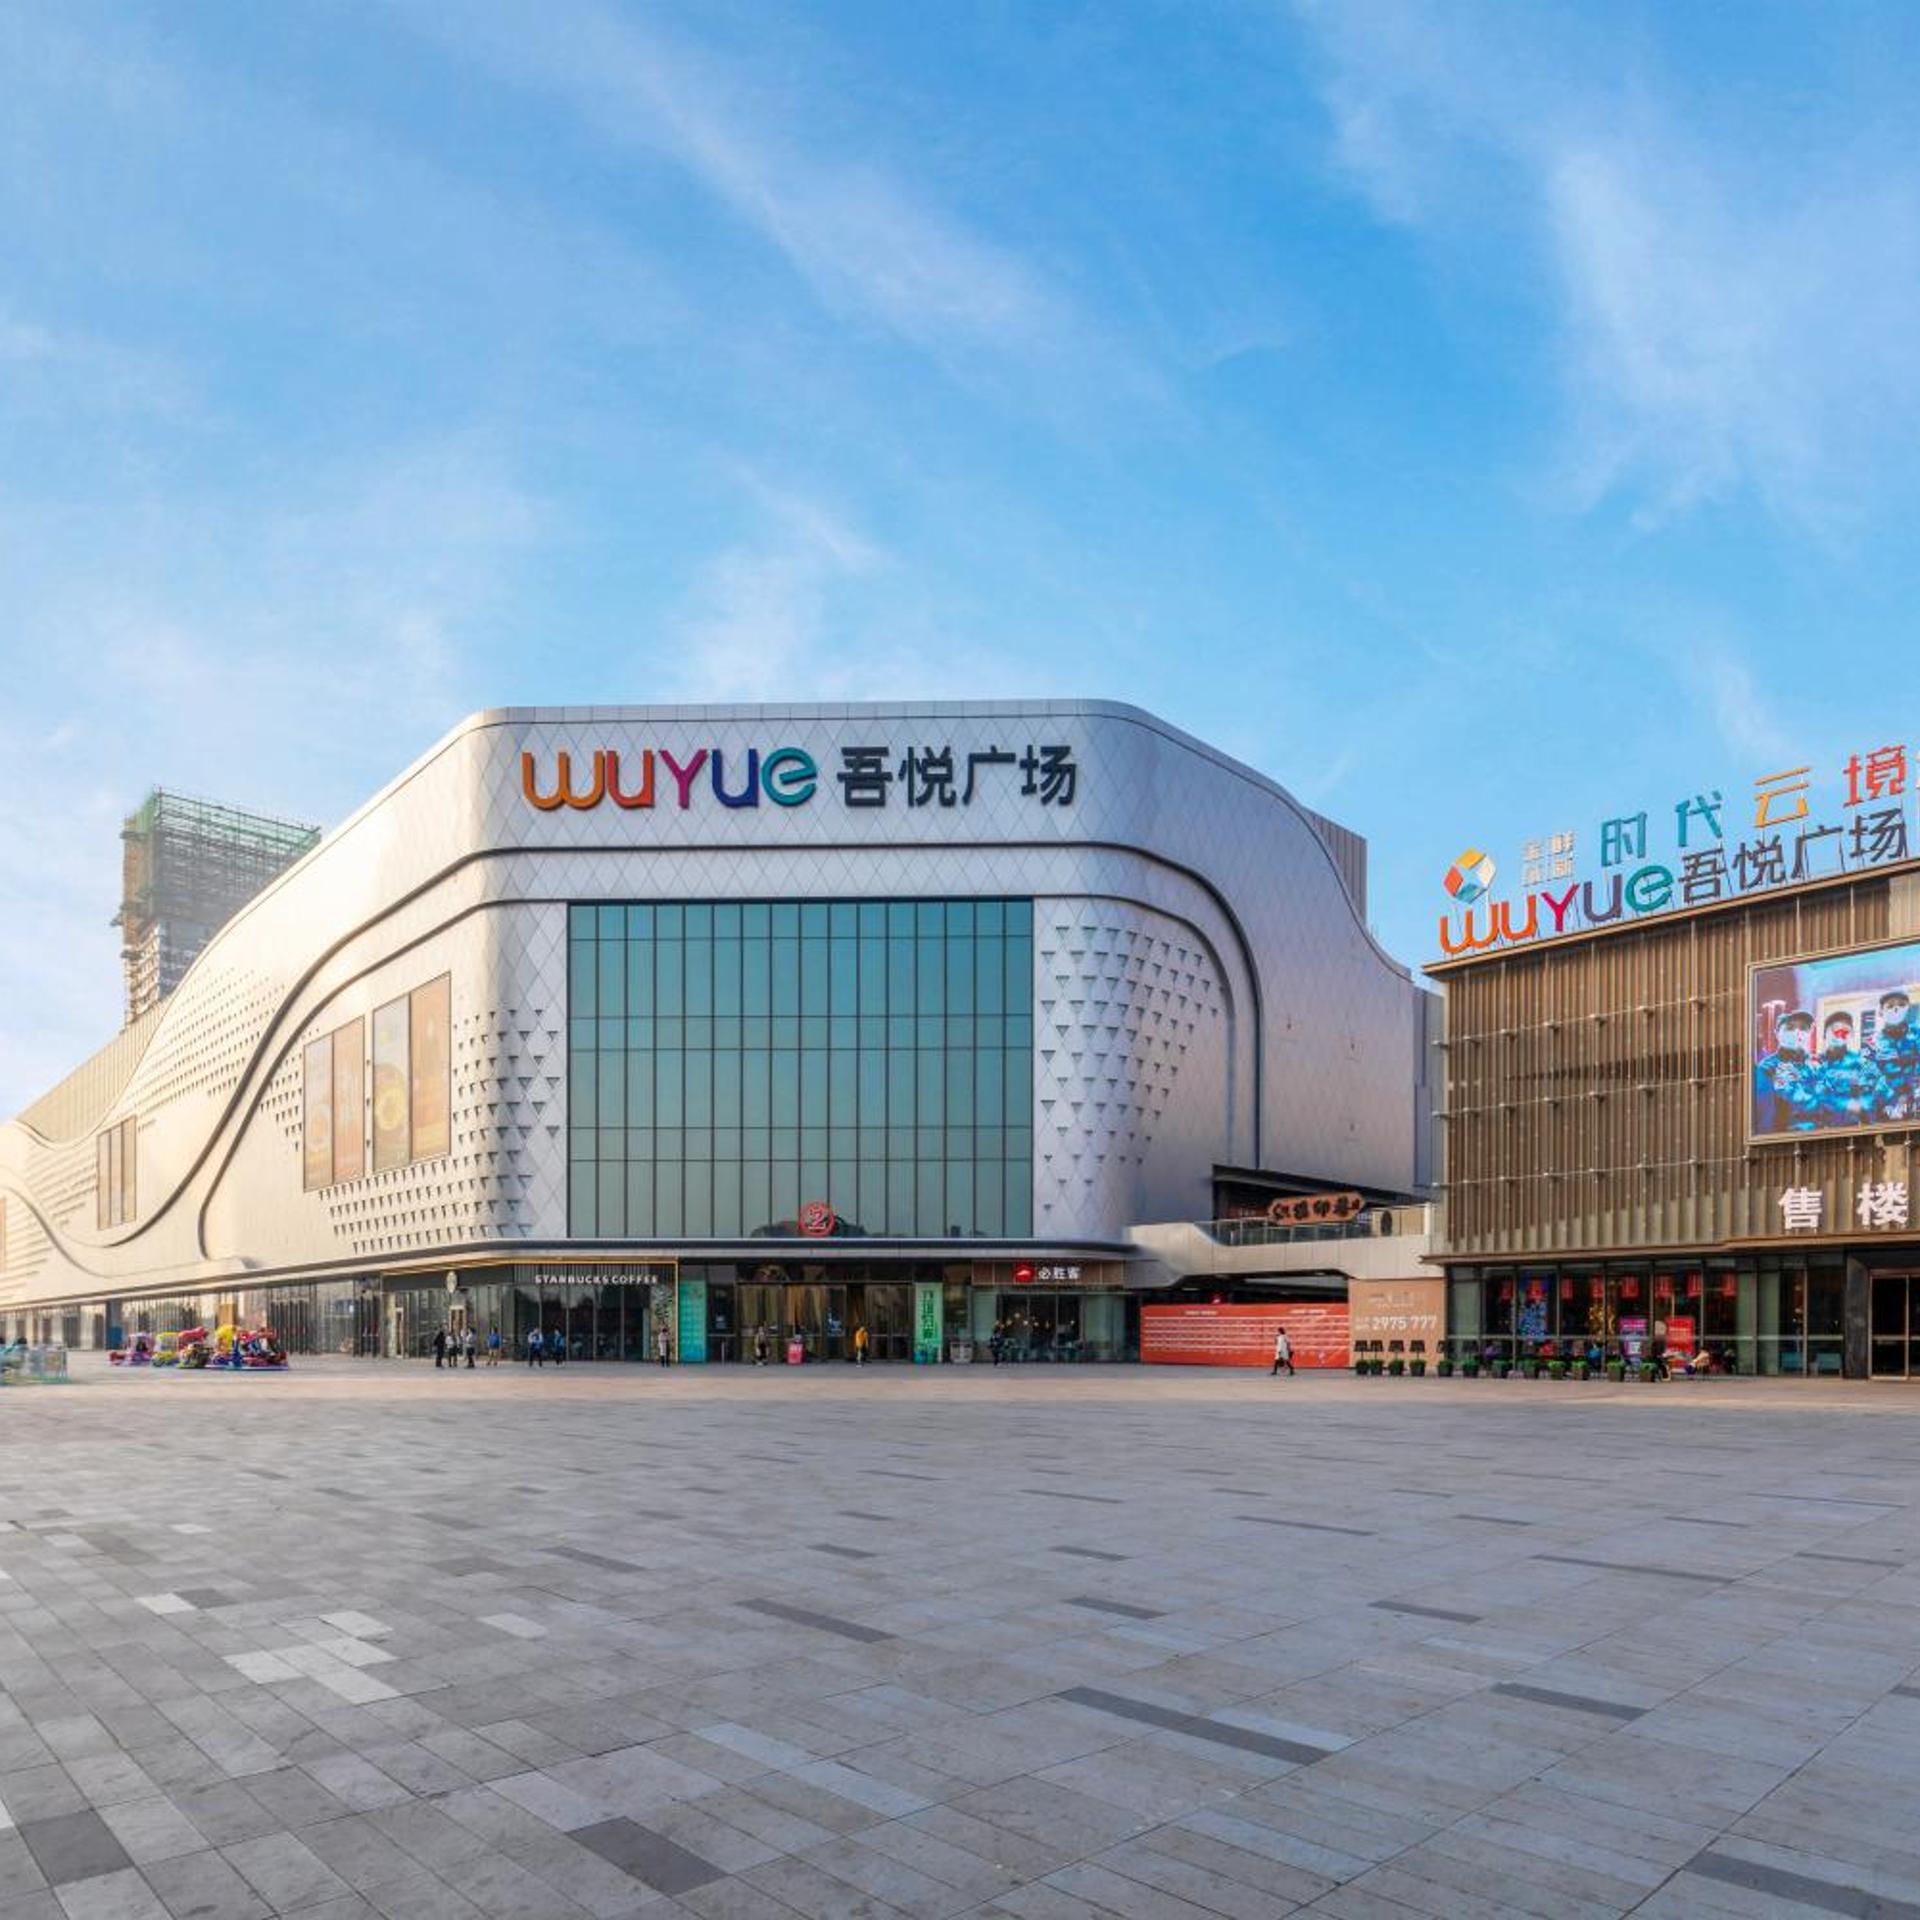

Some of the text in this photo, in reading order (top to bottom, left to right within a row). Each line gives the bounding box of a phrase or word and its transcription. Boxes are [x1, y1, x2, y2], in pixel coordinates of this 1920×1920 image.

[837, 745, 1077, 807] 吾悦广场
[1601, 745, 1906, 866] 时代云境
[1678, 809, 1908, 904] 吾悦广场
[1778, 1182, 1909, 1229] 售楼
[535, 1275, 658, 1285] STARBUCKS COFFEE
[1038, 1266, 1080, 1280] 必胜客
